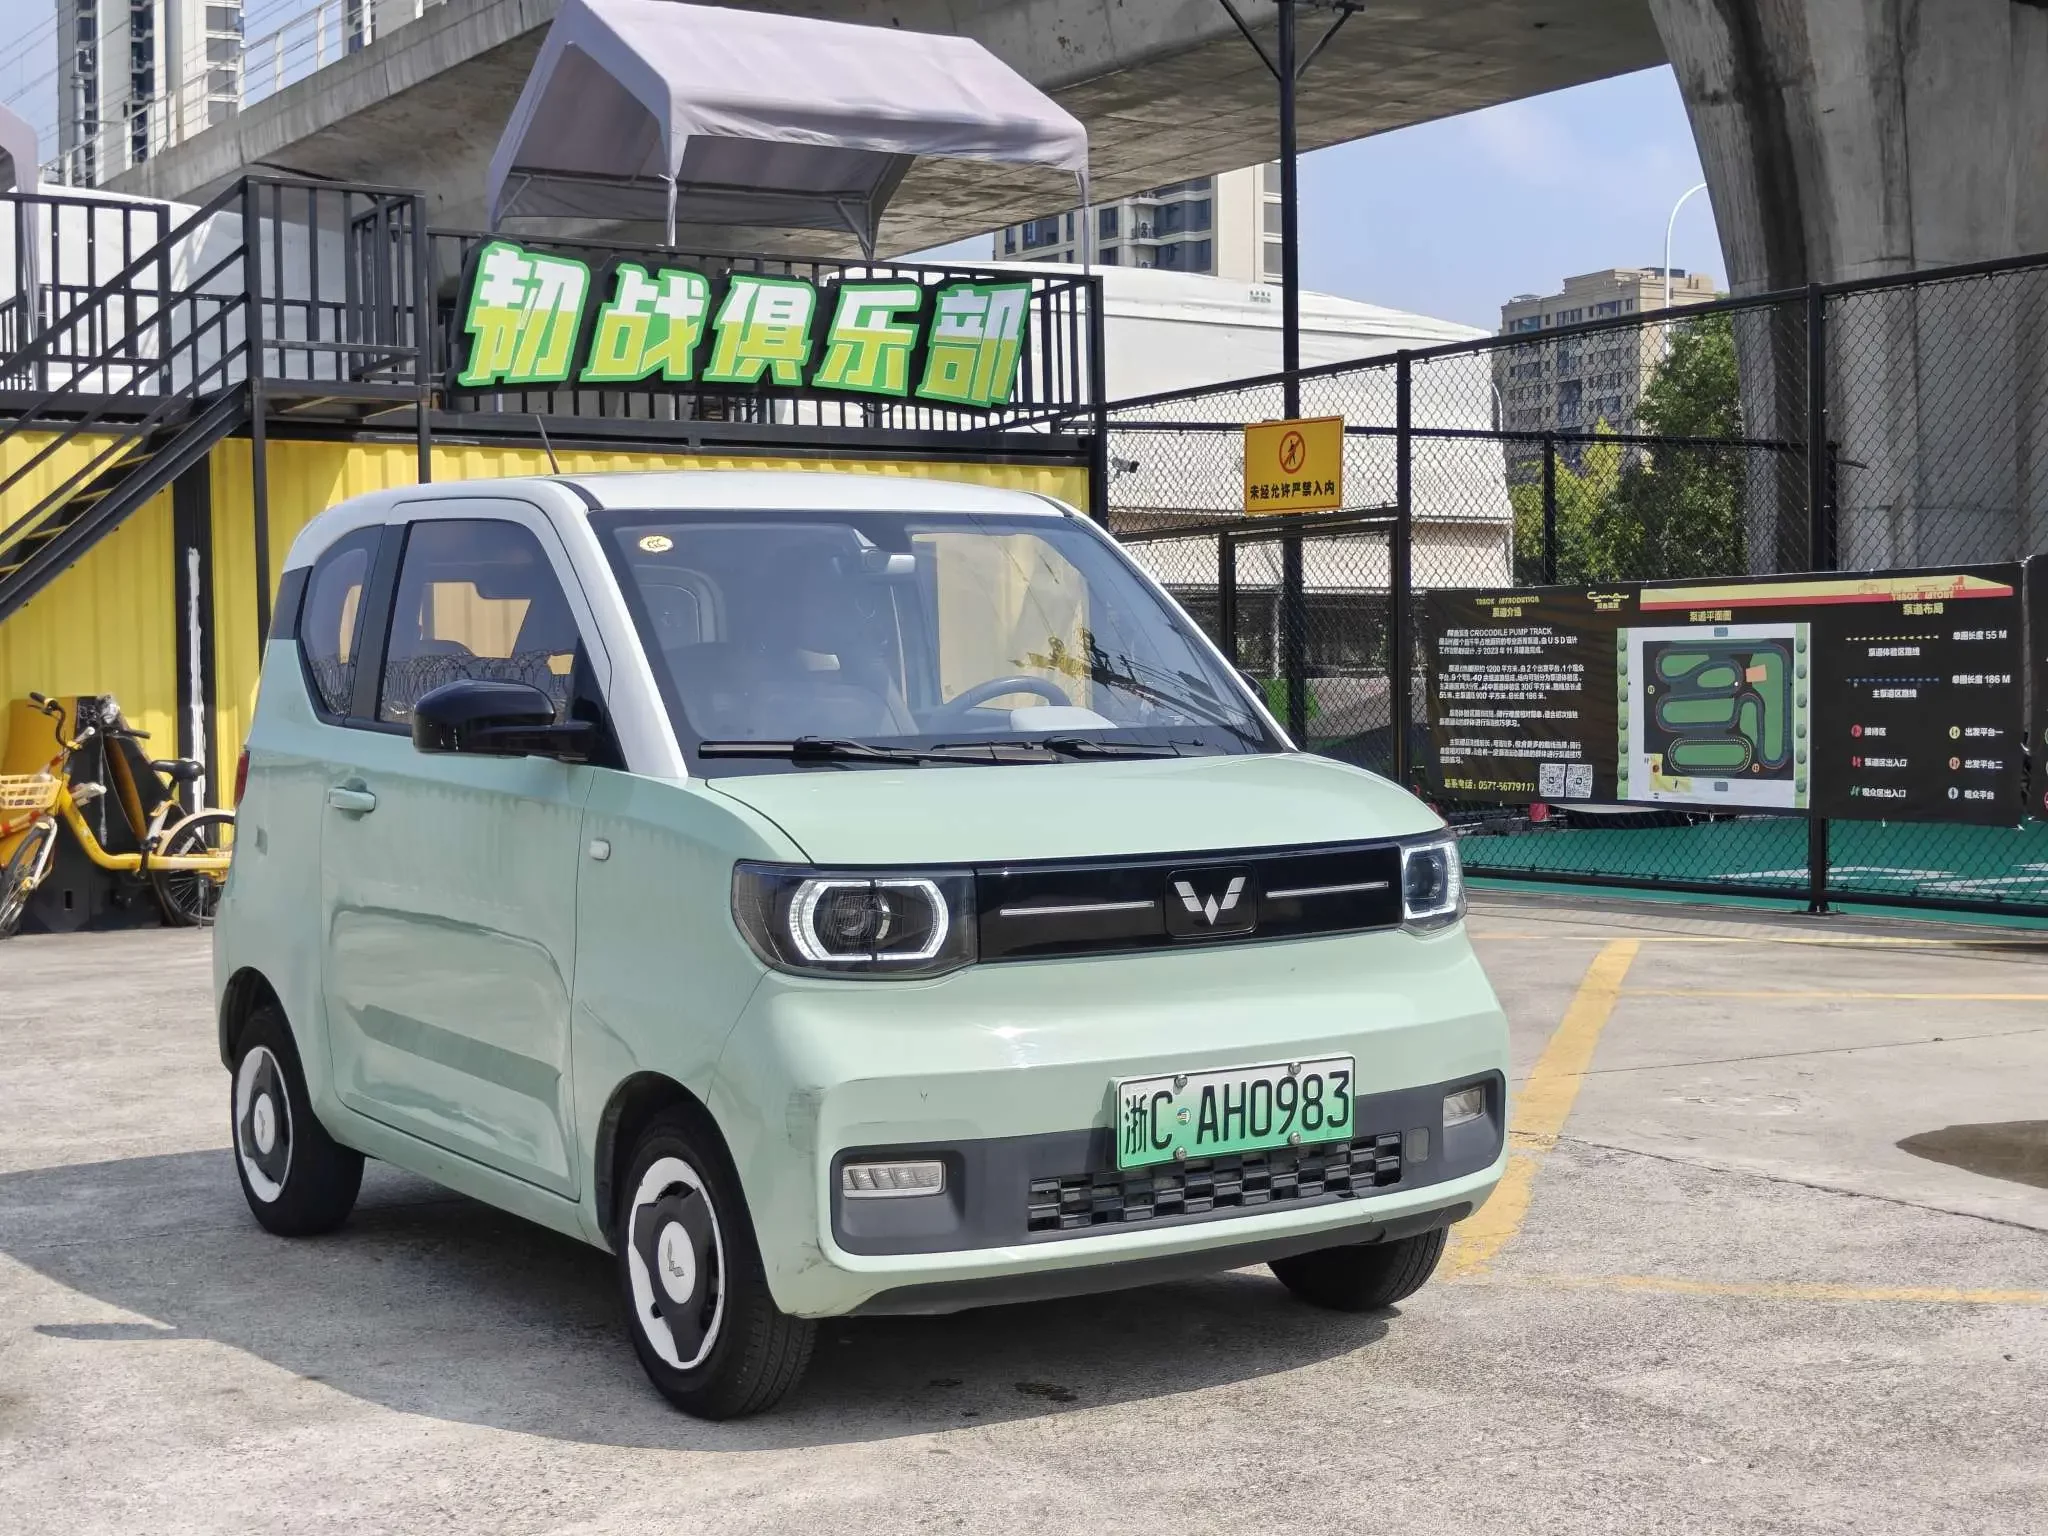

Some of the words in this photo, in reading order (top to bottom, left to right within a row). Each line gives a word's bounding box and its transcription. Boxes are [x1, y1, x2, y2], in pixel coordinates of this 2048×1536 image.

[1250, 480, 1335, 500] 未经允许严禁入内
[1903, 602, 1944, 616] 泵道布局
[1470, 628, 1508, 637] CROCODILE
[1509, 628, 1529, 636] PUMP
[1530, 627, 1552, 635] TRACK
[1986, 630, 1997, 640] 55
[1999, 630, 2008, 639] M
[1985, 675, 2001, 684] 186
[2002, 675, 2011, 684] M
[1965, 727, 2004, 737] 出发平台一
[1965, 760, 2003, 769] 出发平台二
[1862, 787, 1906, 798] 观众区出入口
[1964, 790, 1995, 800] 观众平台
